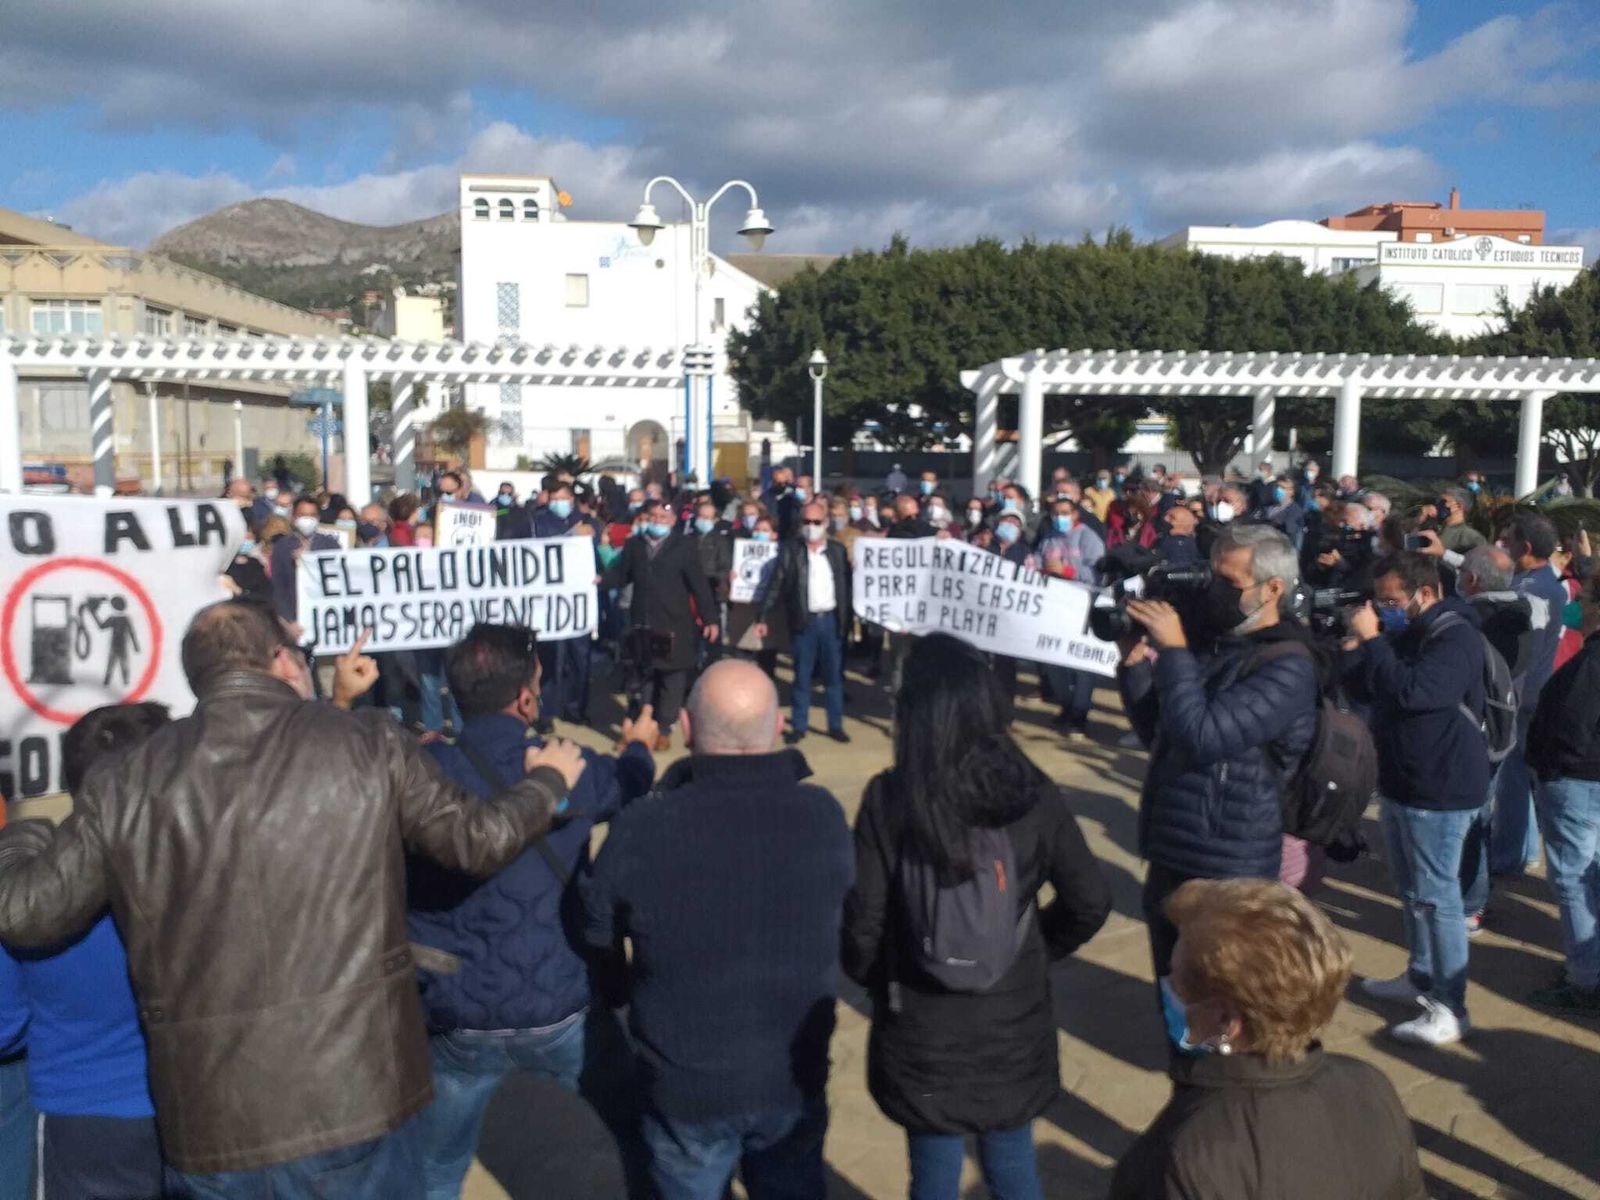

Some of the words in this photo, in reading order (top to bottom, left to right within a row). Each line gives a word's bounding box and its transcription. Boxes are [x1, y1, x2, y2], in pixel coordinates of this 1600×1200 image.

[1384, 247, 1427, 260] INSTITUTO
[1432, 248, 1473, 261] CATOLICO
[1494, 250, 1534, 262] ESTUDIOS
[1541, 250, 1580, 263] TECNICOS
[104, 511, 152, 554] A
[167, 504, 226, 548] LA
[318, 555, 363, 597] EL
[370, 550, 457, 595] PALO
[466, 543, 565, 589] UNIDO
[864, 574, 917, 598] PARA
[930, 574, 966, 601] LAS
[977, 582, 1044, 617] CASAS
[311, 600, 398, 647] JAMAS
[400, 598, 464, 641] SERA
[469, 592, 589, 633] VENCIDO
[864, 602, 891, 622] DE
[905, 601, 927, 623] LA
[939, 605, 998, 638] PLAYA
